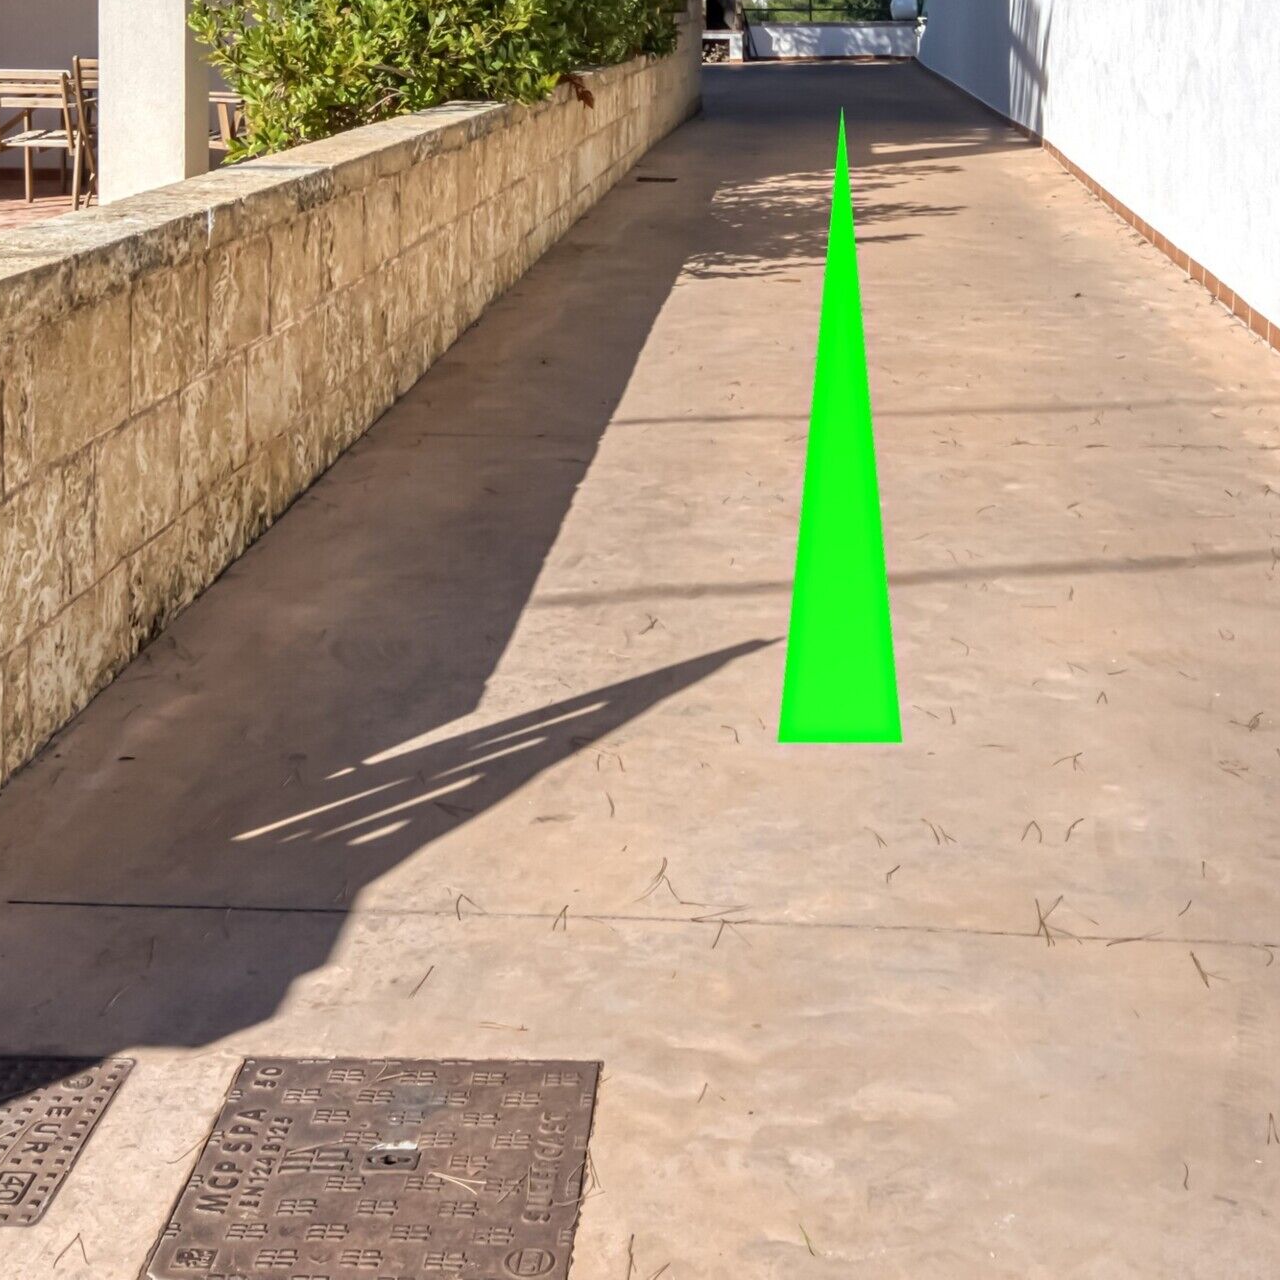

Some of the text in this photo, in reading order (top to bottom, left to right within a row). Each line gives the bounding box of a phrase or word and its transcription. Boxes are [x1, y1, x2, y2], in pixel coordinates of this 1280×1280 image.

[21, 1105, 71, 1154] EUR
[195, 1161, 243, 1215] MCP
[252, 1067, 284, 1088] 50
